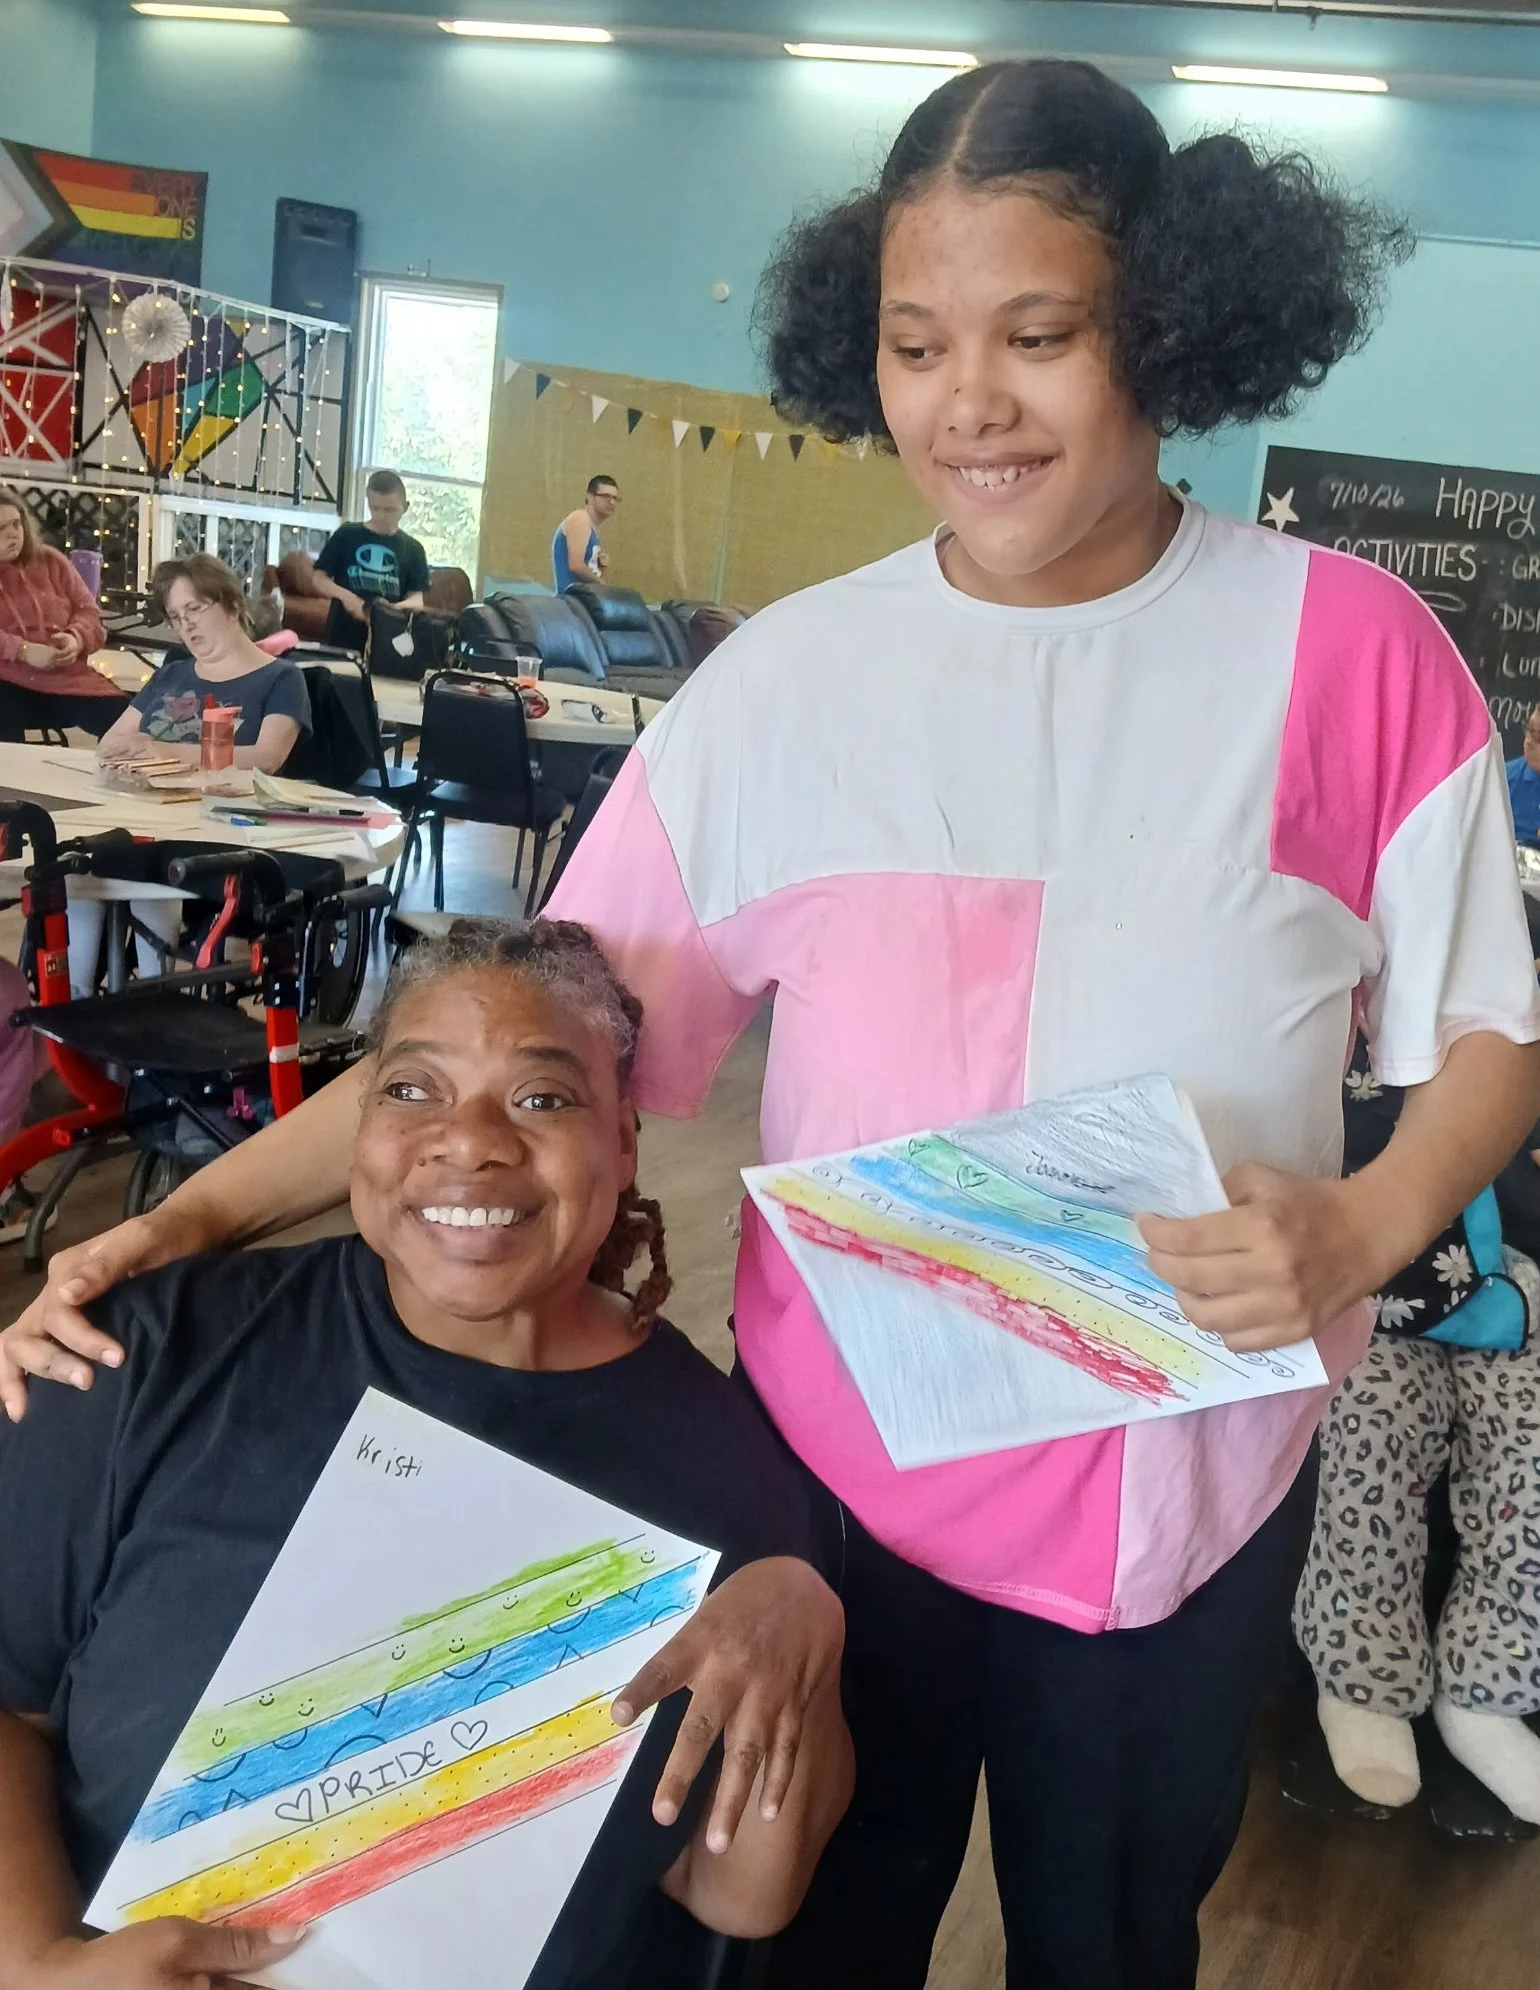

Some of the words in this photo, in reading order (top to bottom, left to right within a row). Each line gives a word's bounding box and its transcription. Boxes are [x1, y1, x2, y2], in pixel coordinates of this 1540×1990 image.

[1501, 602, 1540, 634] DIS
[357, 1434, 422, 1477] Kristi
[319, 1741, 442, 1813] PRIDE
